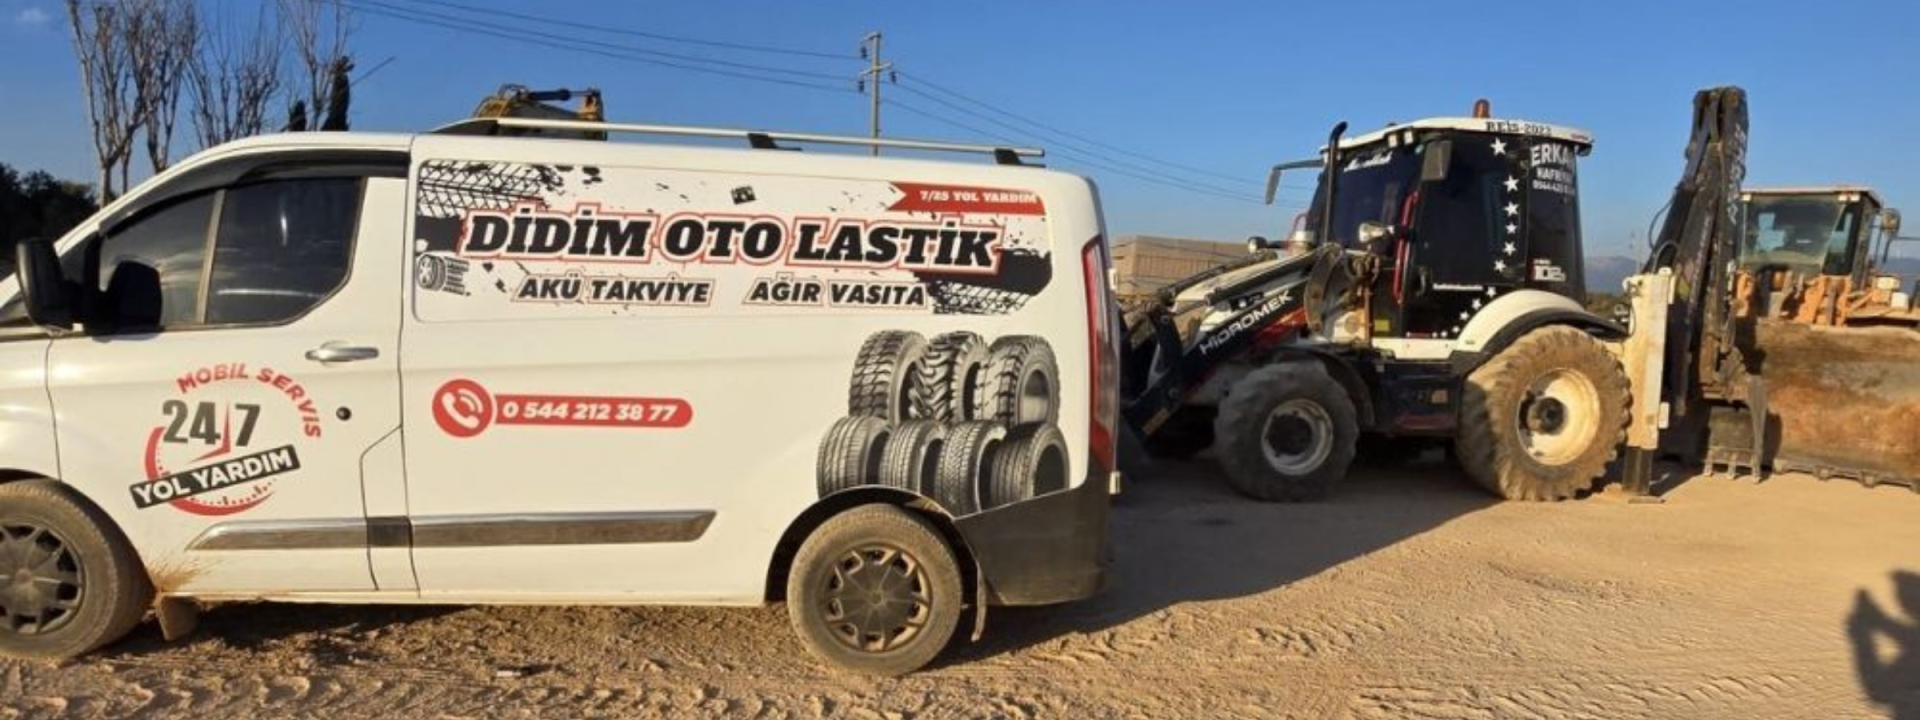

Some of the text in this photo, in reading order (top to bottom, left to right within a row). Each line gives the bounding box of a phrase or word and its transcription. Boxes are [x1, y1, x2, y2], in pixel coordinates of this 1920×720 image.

[952, 191, 981, 203] YOL
[983, 192, 1038, 205] YARDIM
[465, 207, 998, 268] DİDİM OTO LASTİK
[518, 272, 925, 306] AKÜ TAKVİYE AĞIR VASITA
[502, 401, 678, 421] 0 544 212 38 77
[132, 450, 293, 504] YOL YARDIM
